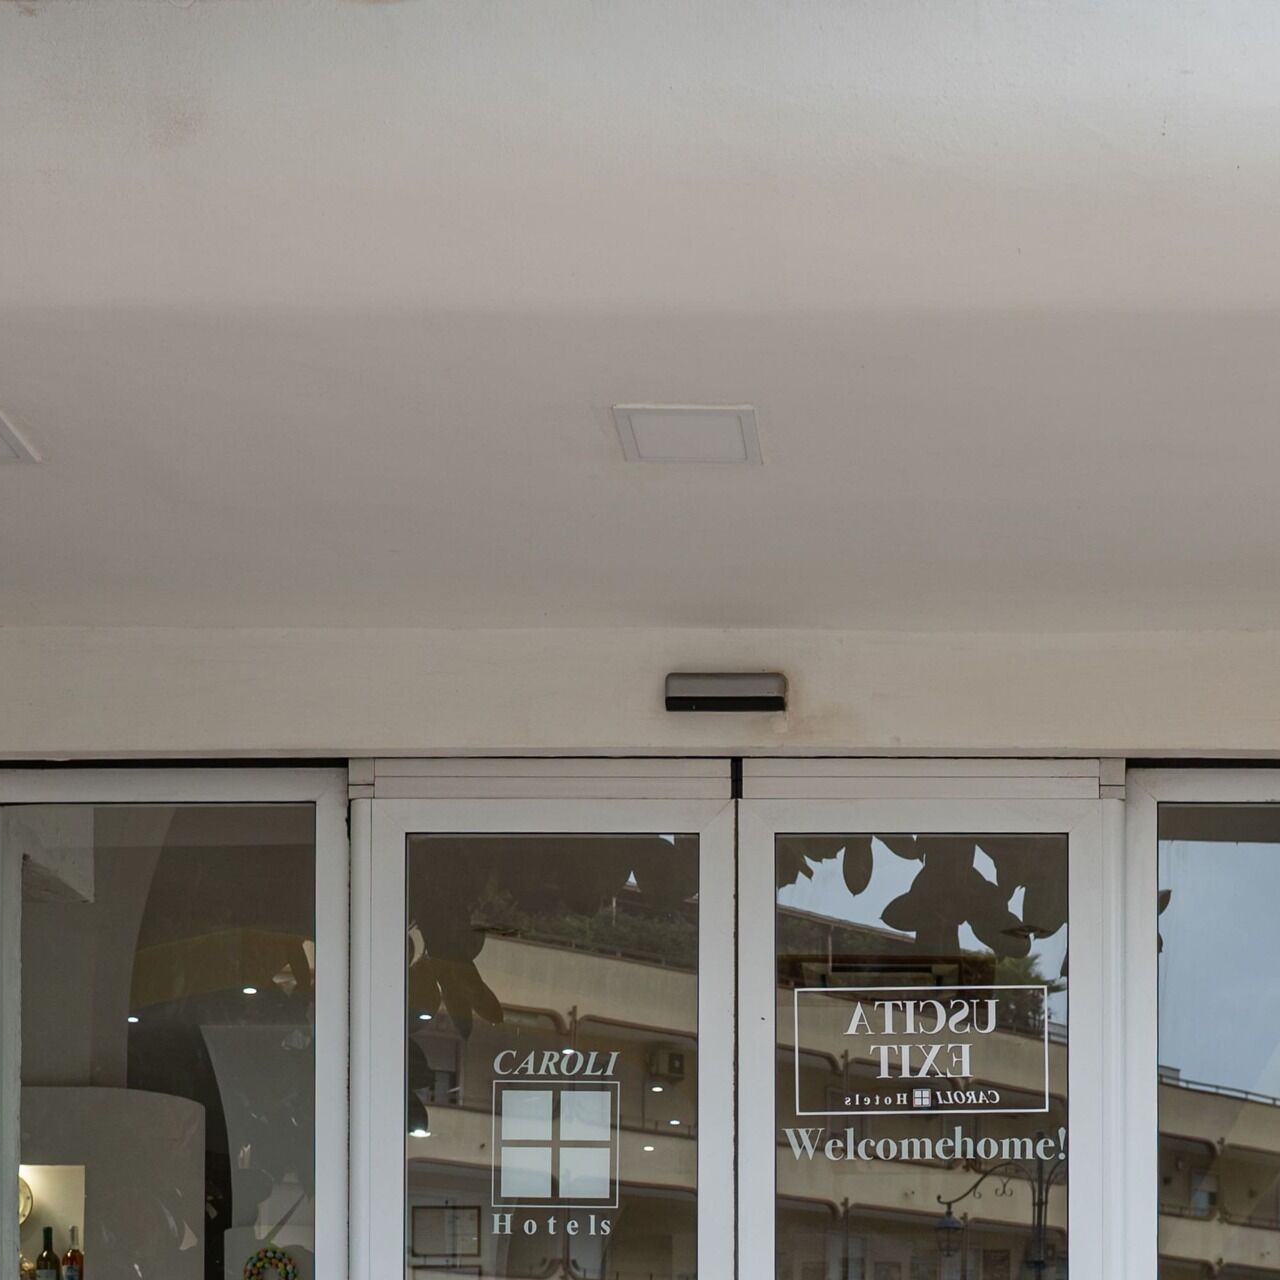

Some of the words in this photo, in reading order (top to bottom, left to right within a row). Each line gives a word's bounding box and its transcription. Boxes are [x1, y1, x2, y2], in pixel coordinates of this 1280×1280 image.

[493, 1050, 620, 1076] CAROLI
[782, 1125, 1068, 1162] Welcomehome!
[491, 1213, 612, 1235] Hotels
